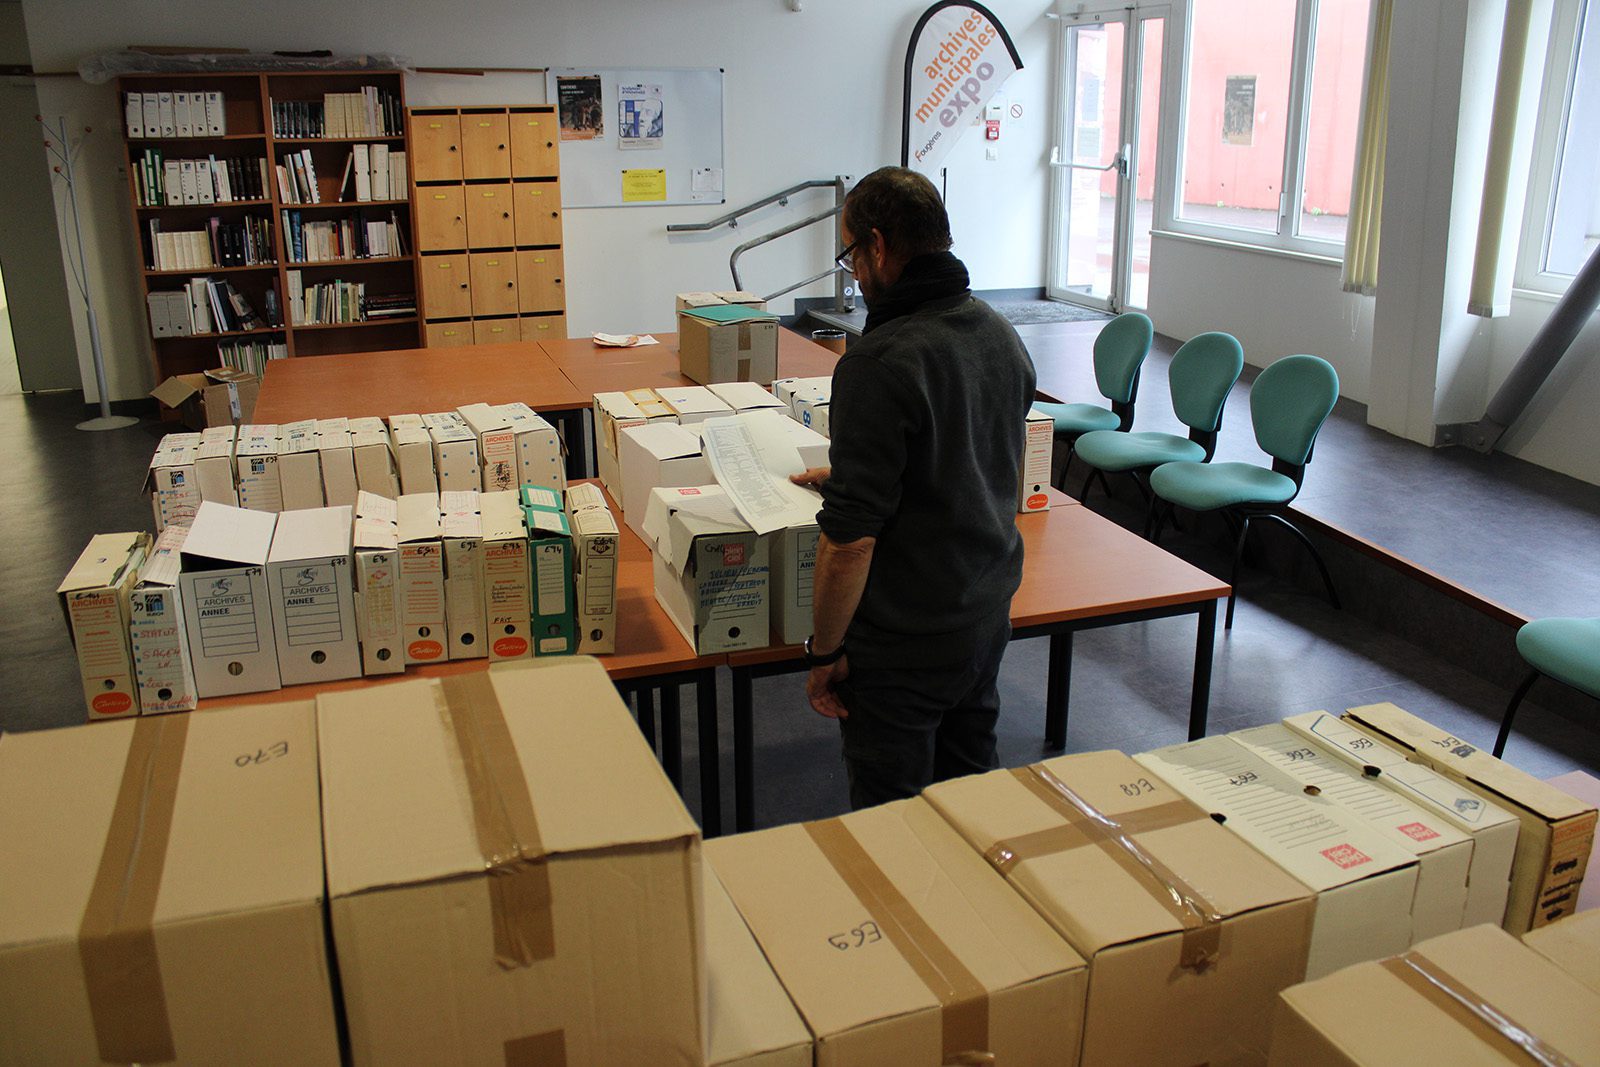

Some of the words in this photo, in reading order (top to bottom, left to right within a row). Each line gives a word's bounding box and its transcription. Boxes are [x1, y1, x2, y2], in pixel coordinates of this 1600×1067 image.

[924, 11, 983, 80] archives
[914, 24, 997, 124] municipales
[939, 62, 995, 128] expo
[485, 435, 513, 443] ARCHIVES
[460, 541, 478, 551] E92
[486, 548, 523, 557] ARCHIVES
[289, 586, 330, 596] ARCHIVES
[71, 596, 114, 608] ARCHIVES
[204, 596, 246, 606] ARCHIVES
[286, 597, 315, 606] ANNEE
[201, 607, 230, 617] ANNEE
[1349, 737, 1374, 749] E65
[235, 741, 288, 768] E70
[1286, 748, 1316, 761] E66
[1120, 778, 1156, 796] E68
[828, 920, 882, 951] E69
